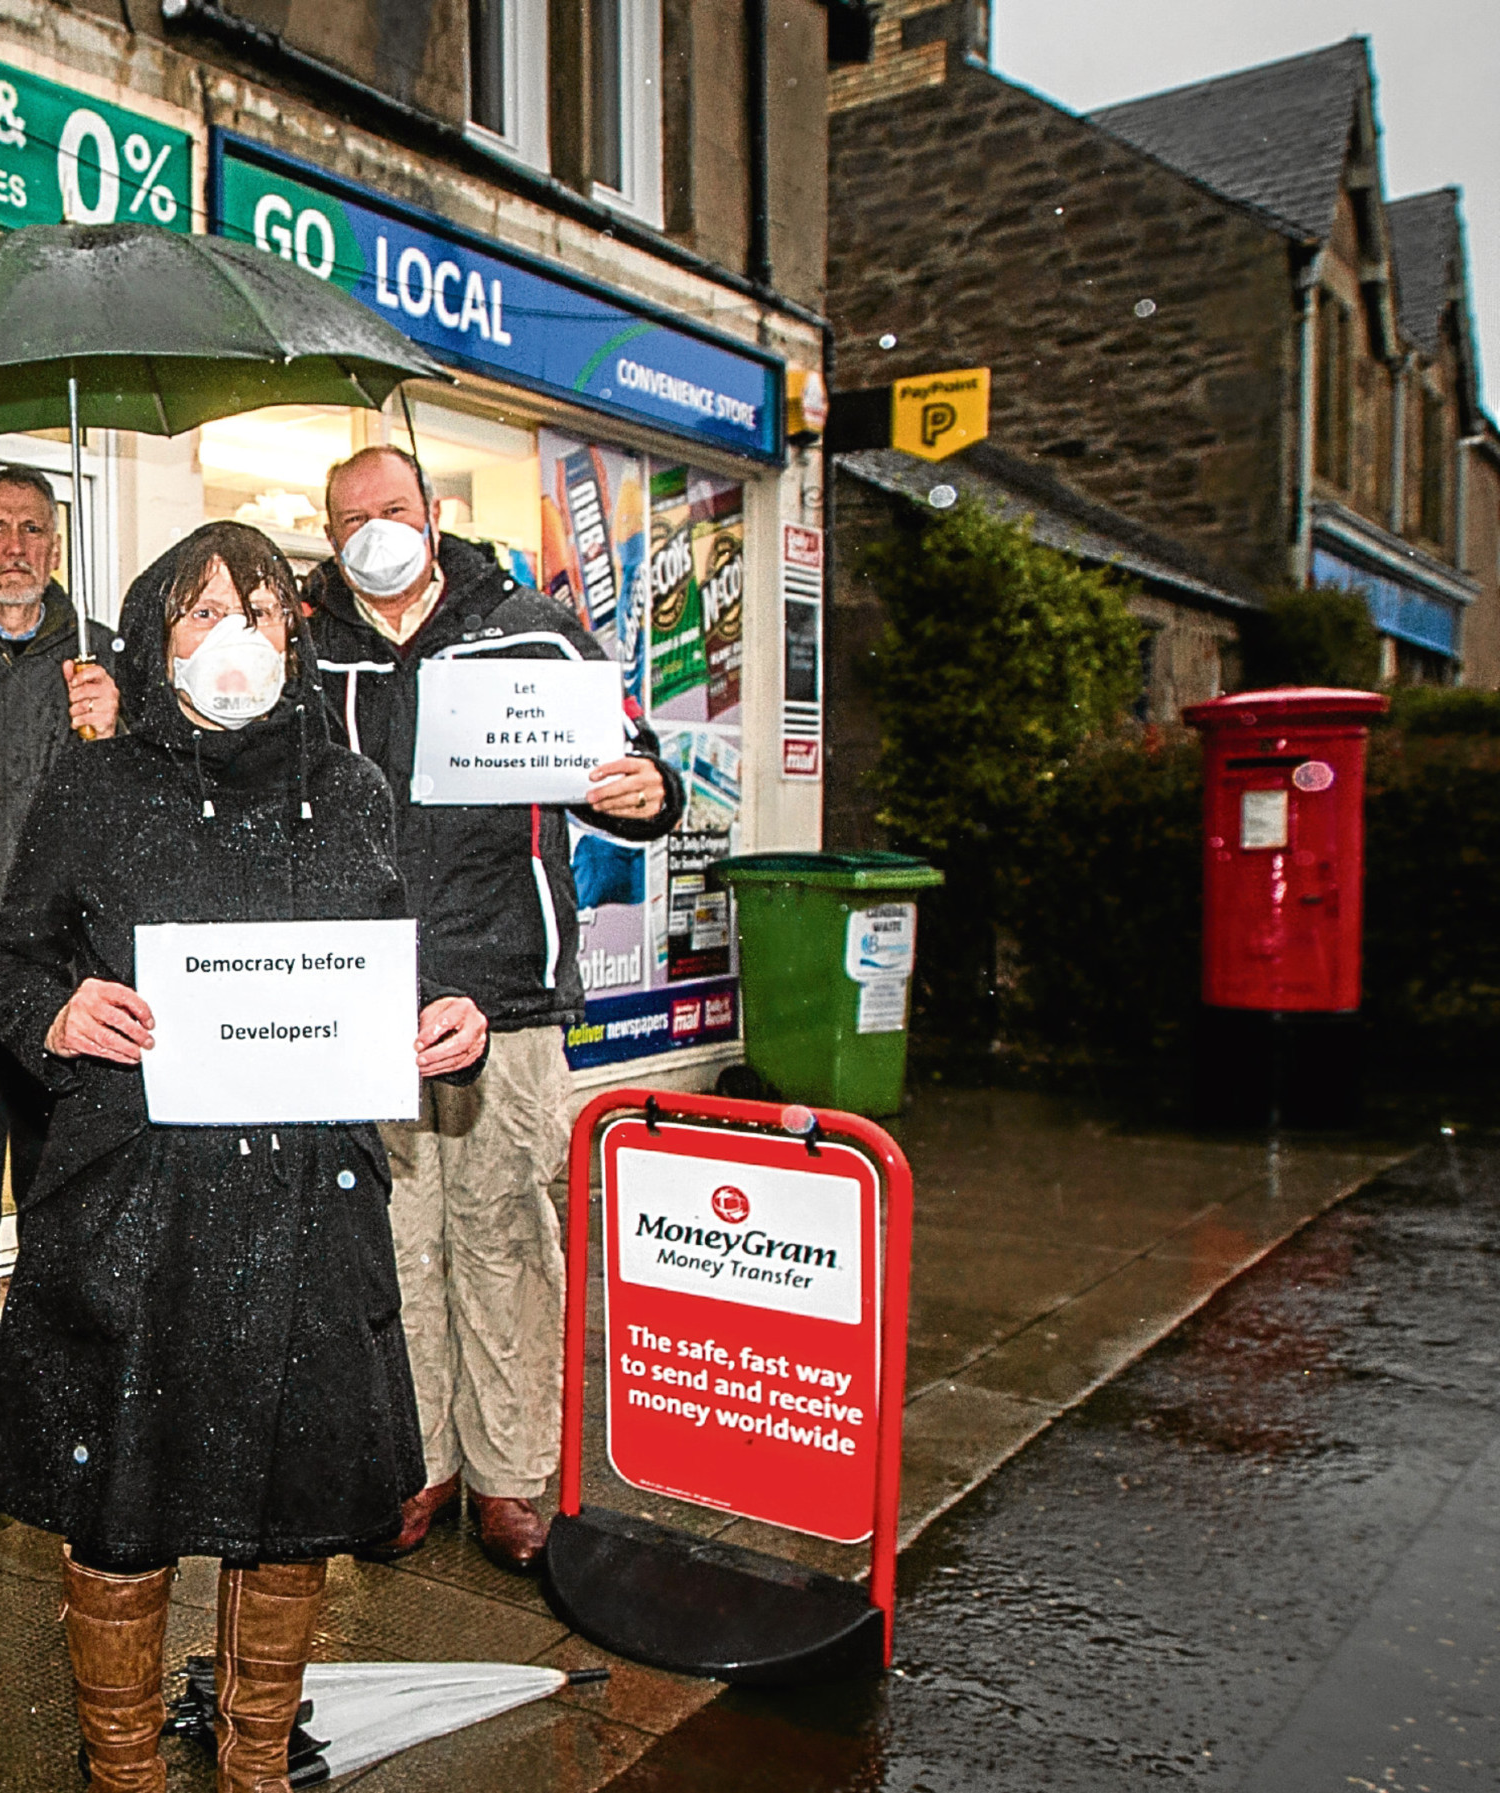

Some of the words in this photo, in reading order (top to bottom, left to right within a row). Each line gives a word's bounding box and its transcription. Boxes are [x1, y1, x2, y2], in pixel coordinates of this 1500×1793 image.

[56, 107, 178, 224] 0%
[253, 193, 336, 281] GO
[375, 235, 512, 346] LOCAL
[616, 357, 715, 416] CONVENIENCE
[714, 392, 757, 431] STORE
[900, 378, 978, 400] PayPoint
[514, 682, 536, 695] Let
[506, 707, 545, 719] Perth
[450, 756, 470, 768] No
[474, 756, 526, 768] houses
[530, 756, 549, 768] till
[554, 756, 599, 769] bridge
[185, 955, 296, 975] Democracy
[301, 952, 367, 971] before
[577, 944, 643, 991] otland
[220, 1020, 338, 1043] Developers!
[567, 1023, 606, 1048] deliver
[606, 1011, 669, 1040] newspapers
[634, 1212, 838, 1270] MoneyGram
[656, 1248, 725, 1279] Money
[730, 1259, 814, 1290] Transfer
[626, 1323, 672, 1353] The
[676, 1339, 736, 1371] safe,
[739, 1347, 790, 1379] fast
[795, 1362, 853, 1397] way
[619, 1352, 646, 1377] to
[650, 1363, 709, 1392] send
[713, 1379, 763, 1404] and
[768, 1387, 864, 1426] receive
[627, 1387, 711, 1427] money
[714, 1408, 856, 1456] worldwide
